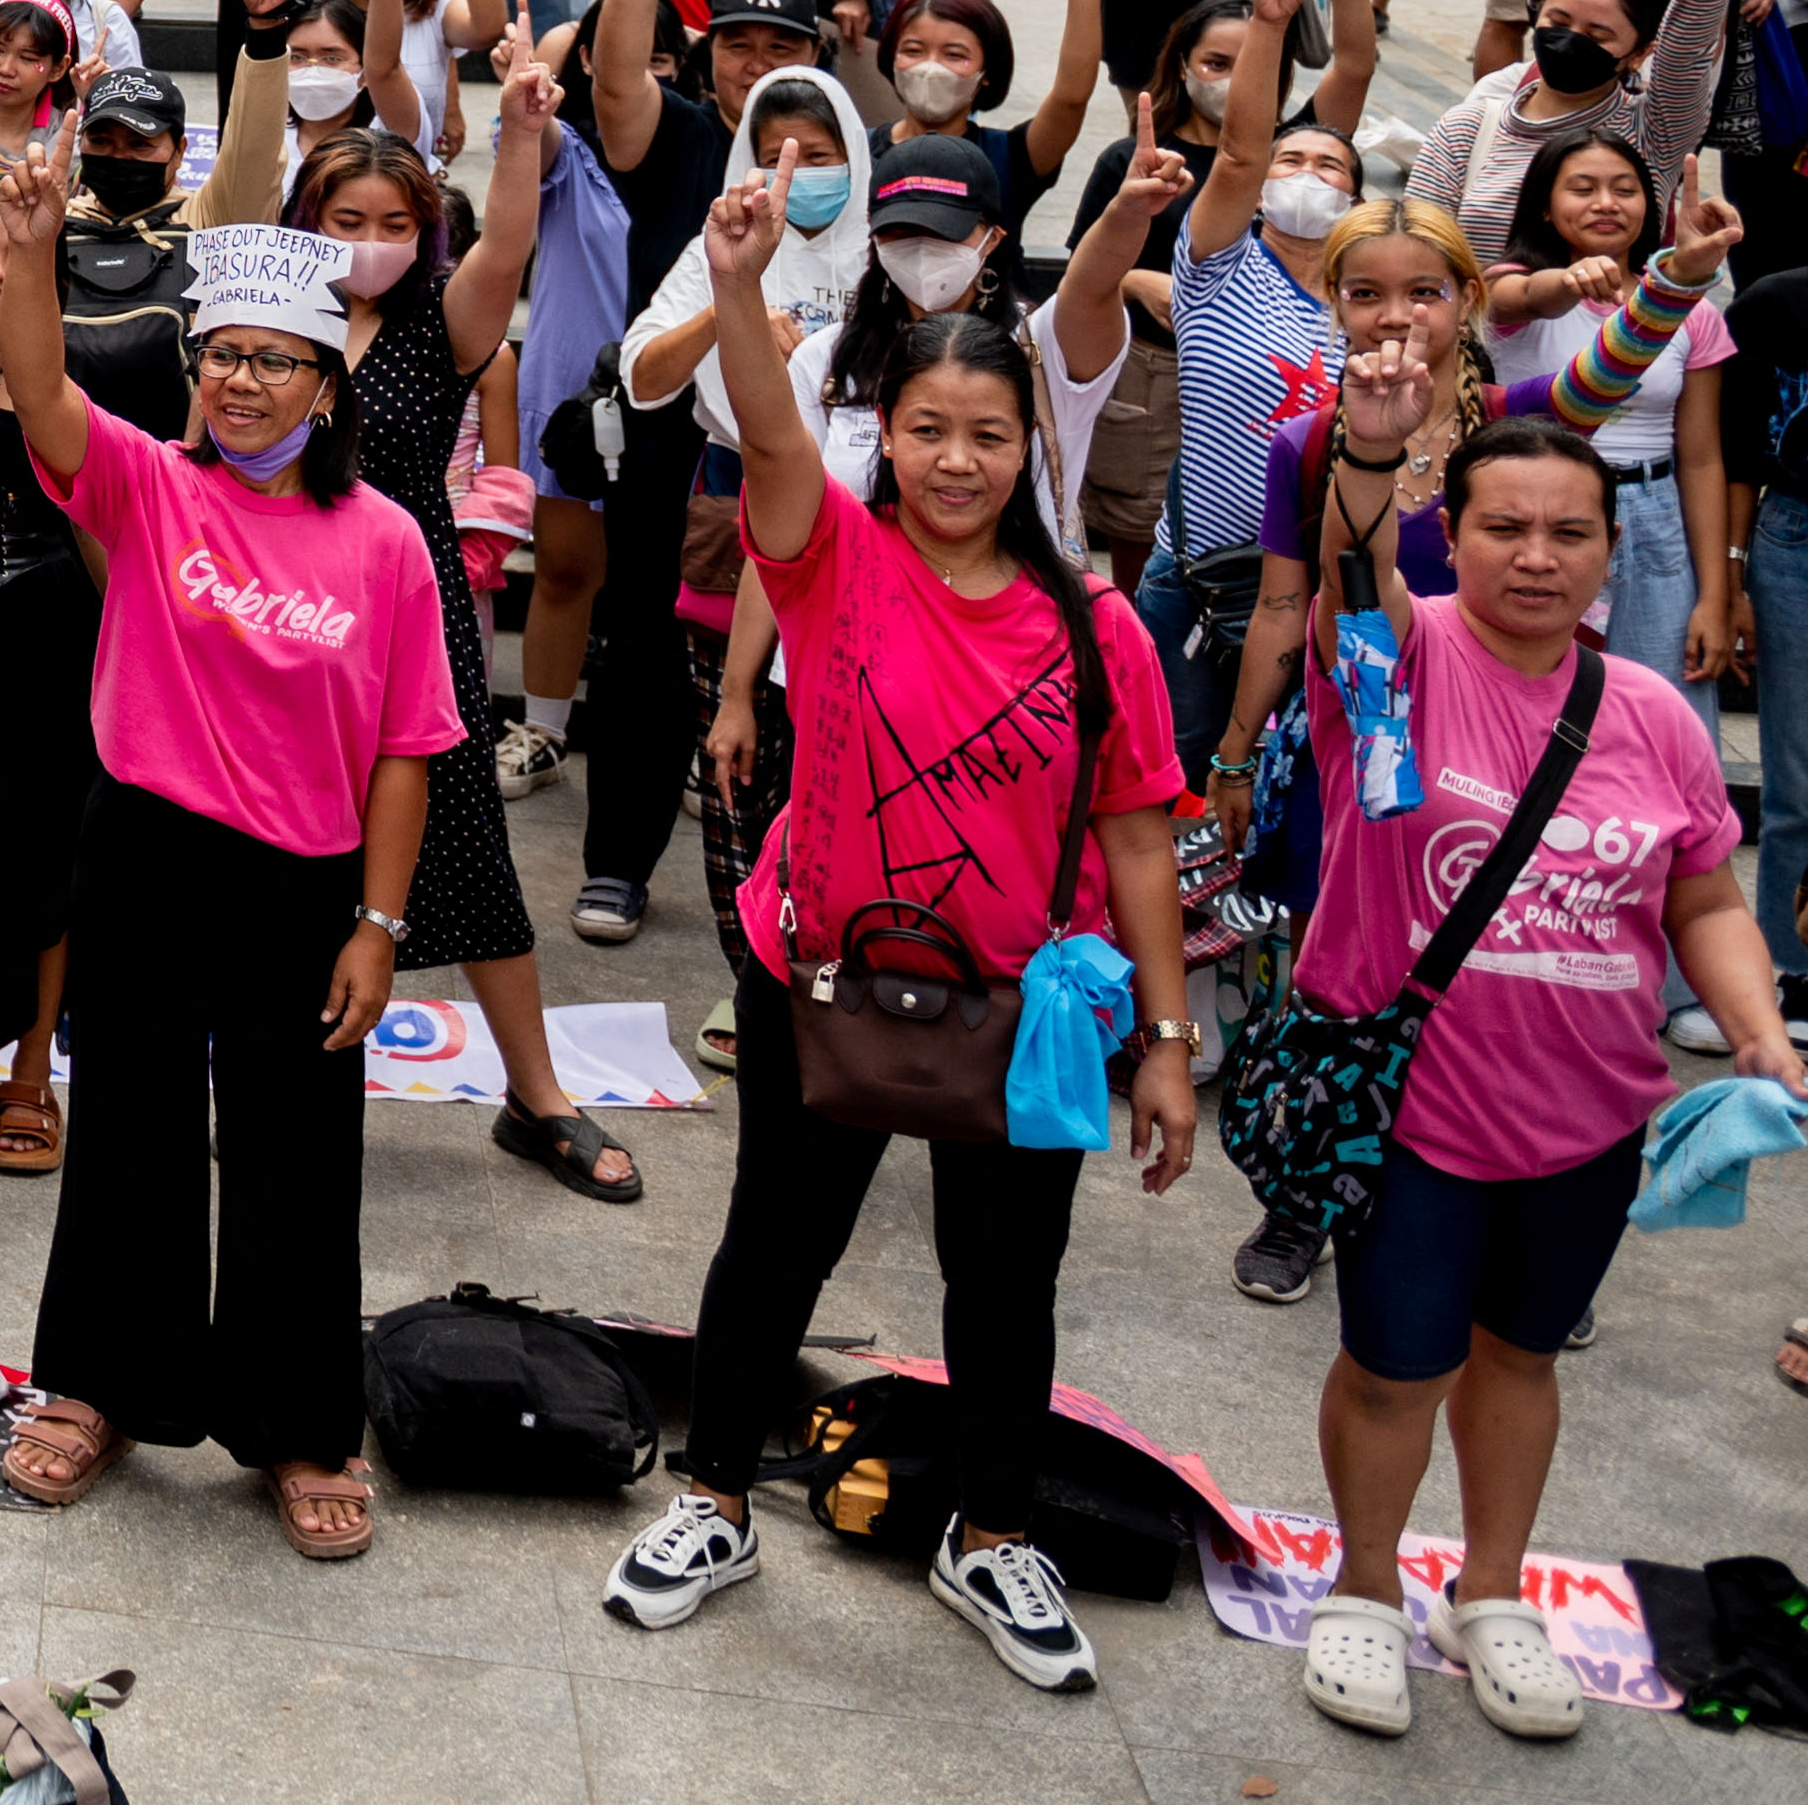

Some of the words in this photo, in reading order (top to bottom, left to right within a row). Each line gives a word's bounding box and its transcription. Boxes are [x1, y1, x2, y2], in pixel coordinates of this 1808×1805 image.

[194, 231, 229, 259] PHASE
[231, 227, 264, 250] OUT
[265, 229, 346, 265] JEEPNEY
[179, 550, 356, 640] Gabriela
[212, 598, 271, 637] WON'S
[277, 628, 346, 651] PARTYLIST
[1442, 771, 1494, 802] MULING
[1593, 816, 1659, 869] 67
